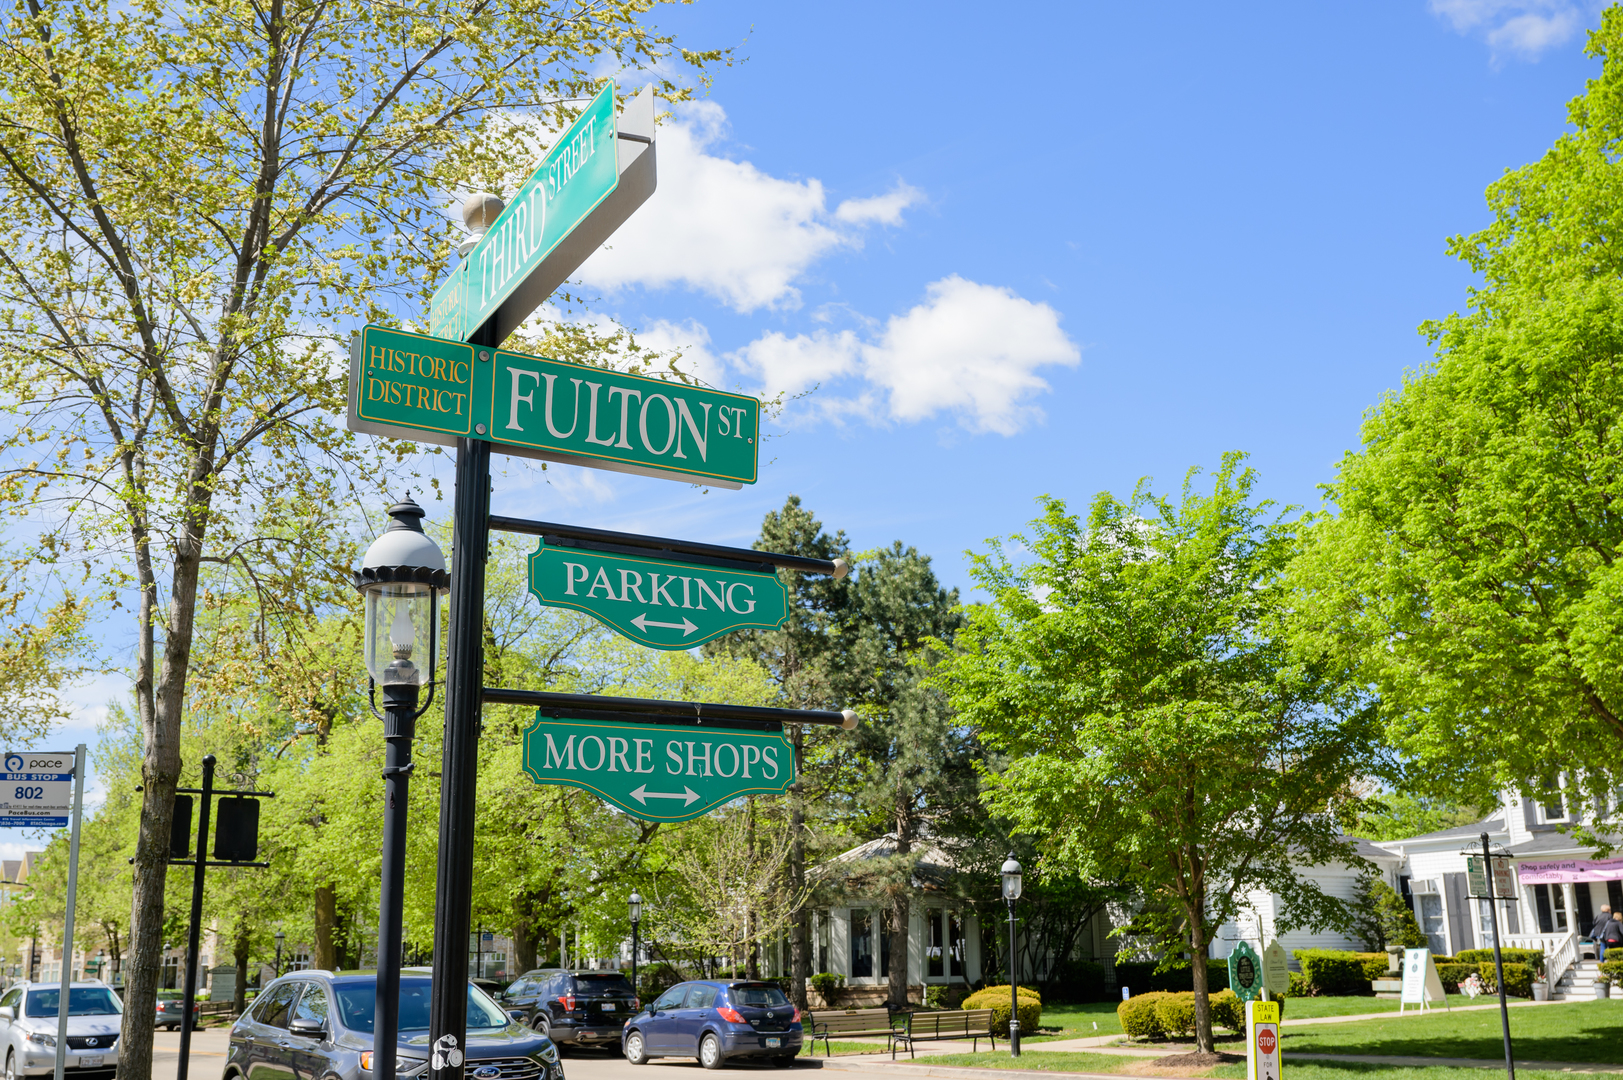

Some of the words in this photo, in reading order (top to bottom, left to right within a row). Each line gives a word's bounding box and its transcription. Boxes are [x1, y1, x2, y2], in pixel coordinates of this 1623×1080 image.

[478, 182, 547, 312] THIRD
[549, 115, 597, 201] STREET
[432, 282, 461, 332] HISTORIC
[368, 345, 469, 384] HISTORIC
[367, 378, 467, 416] DISTRICT
[505, 366, 713, 463] FULTON
[717, 405, 747, 439] ST
[563, 561, 757, 615] PARKING
[29, 760, 62, 769] pace
[543, 733, 655, 774] MORE
[666, 740, 779, 780] SHOPS
[15, 787, 43, 799] 802
[1521, 872, 1563, 880] comfortably
[1257, 1004, 1275, 1013] STATE
[1260, 1013, 1272, 1021] LAW
[1259, 1037, 1275, 1046] STOP
